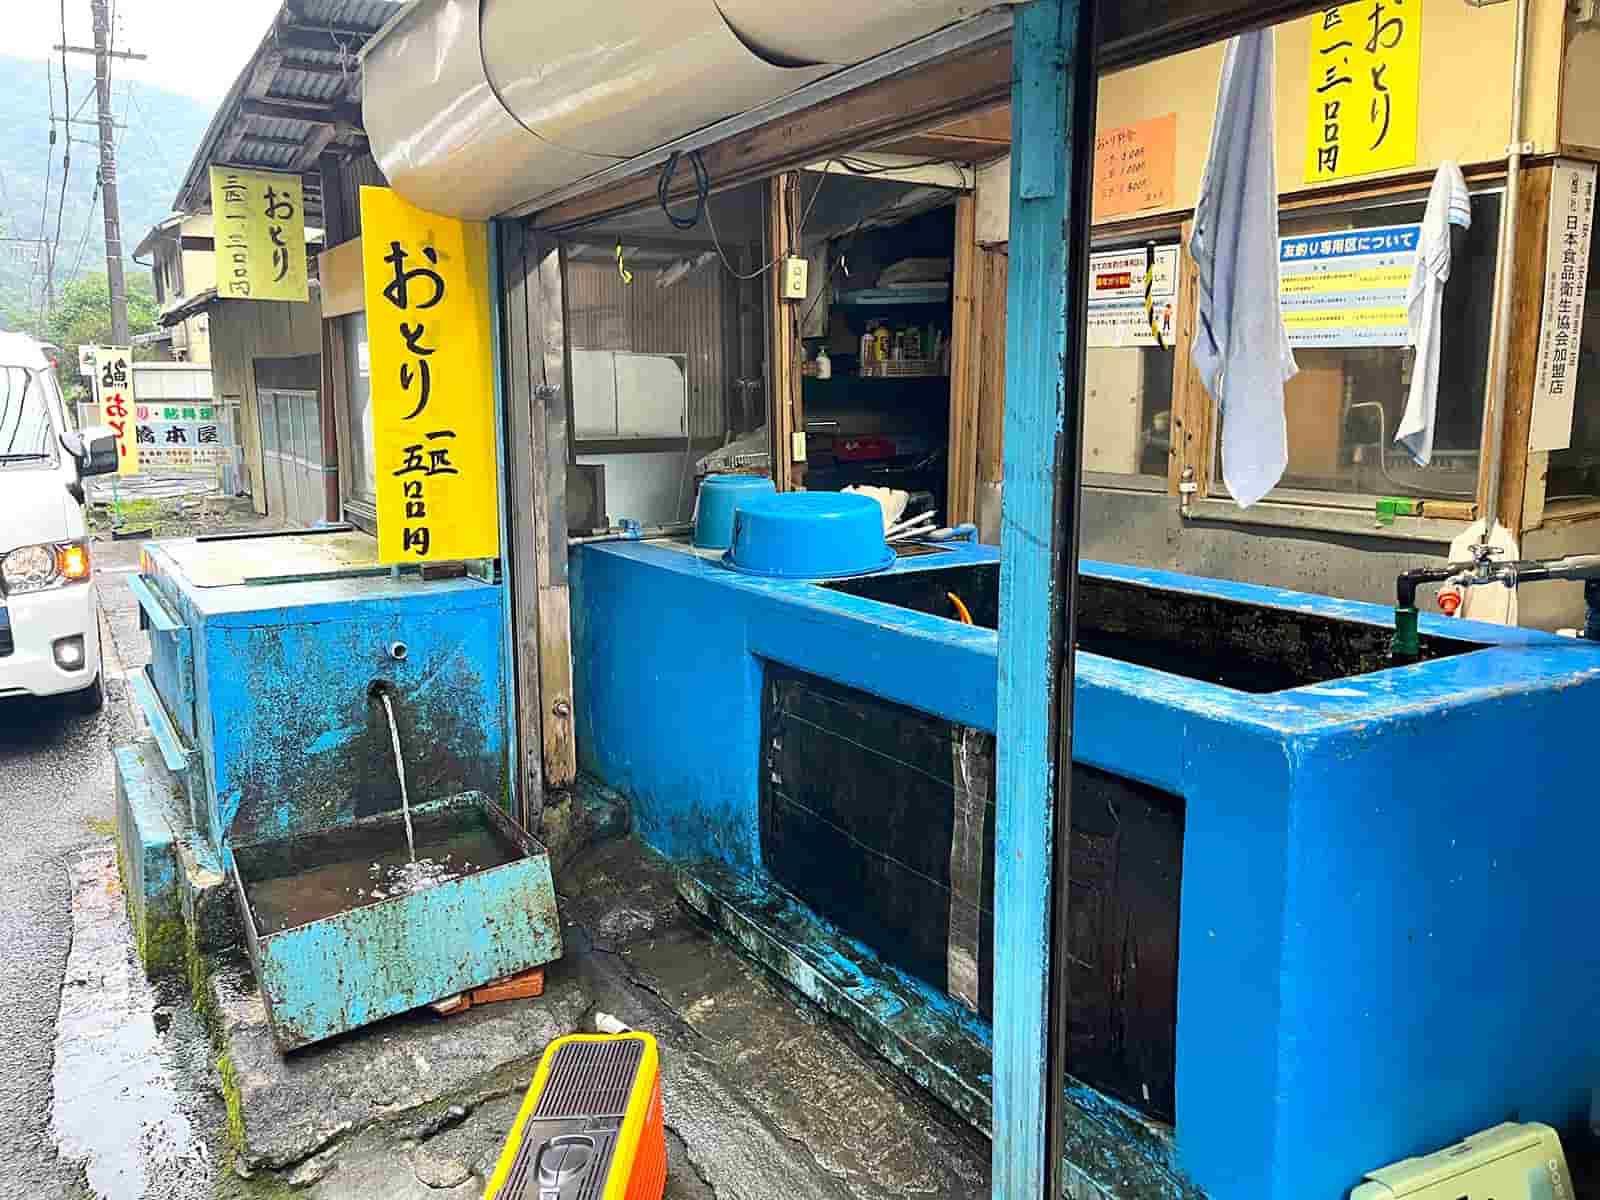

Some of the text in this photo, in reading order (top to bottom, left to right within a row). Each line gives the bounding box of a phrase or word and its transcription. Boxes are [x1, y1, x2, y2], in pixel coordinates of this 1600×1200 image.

[1365, 0, 1404, 151] おとり
[264, 184, 294, 282] おとり
[1283, 232, 1414, 257] 友釣り専用区について
[1549, 215, 1578, 396] 日本食品衛生協会加盟店
[383, 241, 445, 420] おとり
